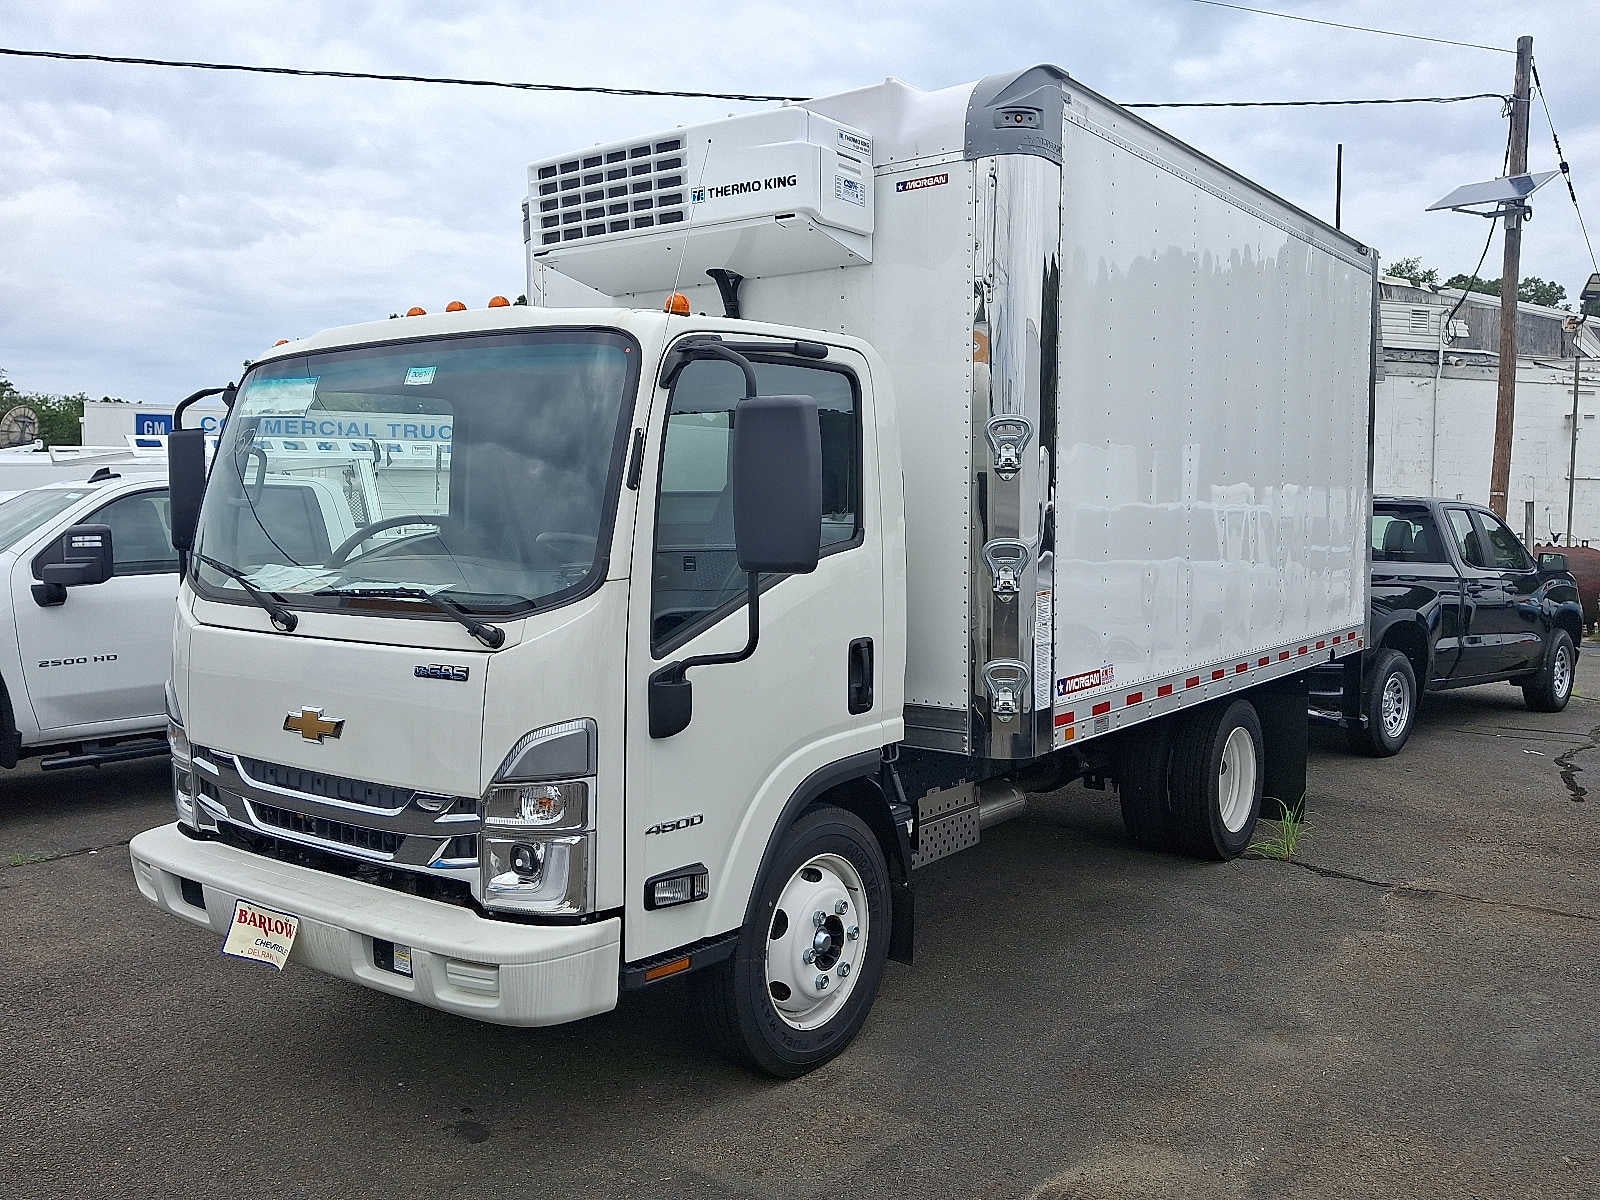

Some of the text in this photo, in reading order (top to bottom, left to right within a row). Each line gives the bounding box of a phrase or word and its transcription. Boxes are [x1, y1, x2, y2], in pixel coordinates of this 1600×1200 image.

[708, 180, 761, 198] THERMO
[764, 174, 797, 190] KING
[905, 175, 947, 190] MORGAN
[143, 420, 166, 435] GM
[200, 416, 452, 440] CMERCIAL TRUC
[38, 654, 118, 668] 2500 HD
[1065, 672, 1100, 692] MORGAN
[645, 814, 704, 835] 4500
[237, 908, 296, 940] BARLOW
[254, 938, 289, 957] CHEVROLE
